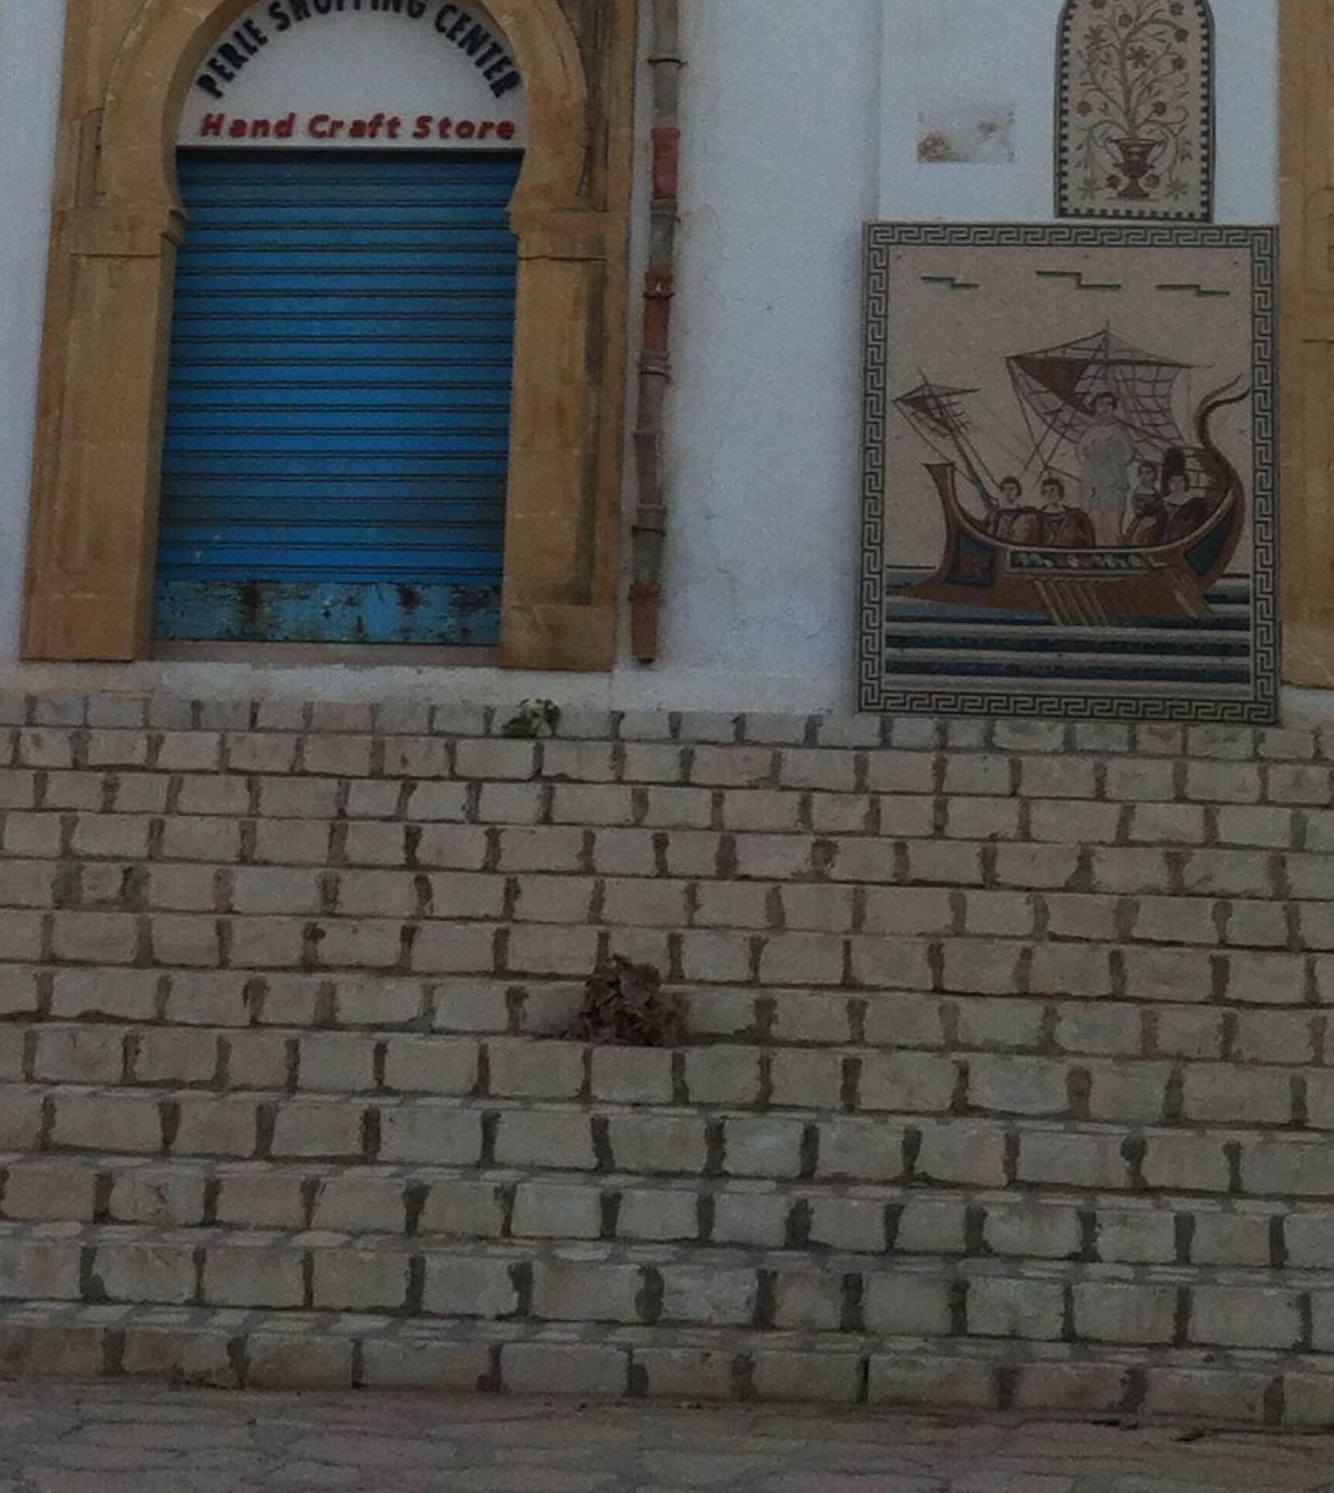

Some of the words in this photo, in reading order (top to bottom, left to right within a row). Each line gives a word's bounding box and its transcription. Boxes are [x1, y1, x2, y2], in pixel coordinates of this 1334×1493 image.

[196, 17, 269, 99] PERLE
[434, 2, 523, 99] CENTER
[200, 112, 297, 139] Hand
[307, 113, 403, 139] Craft
[412, 115, 517, 141] Store
